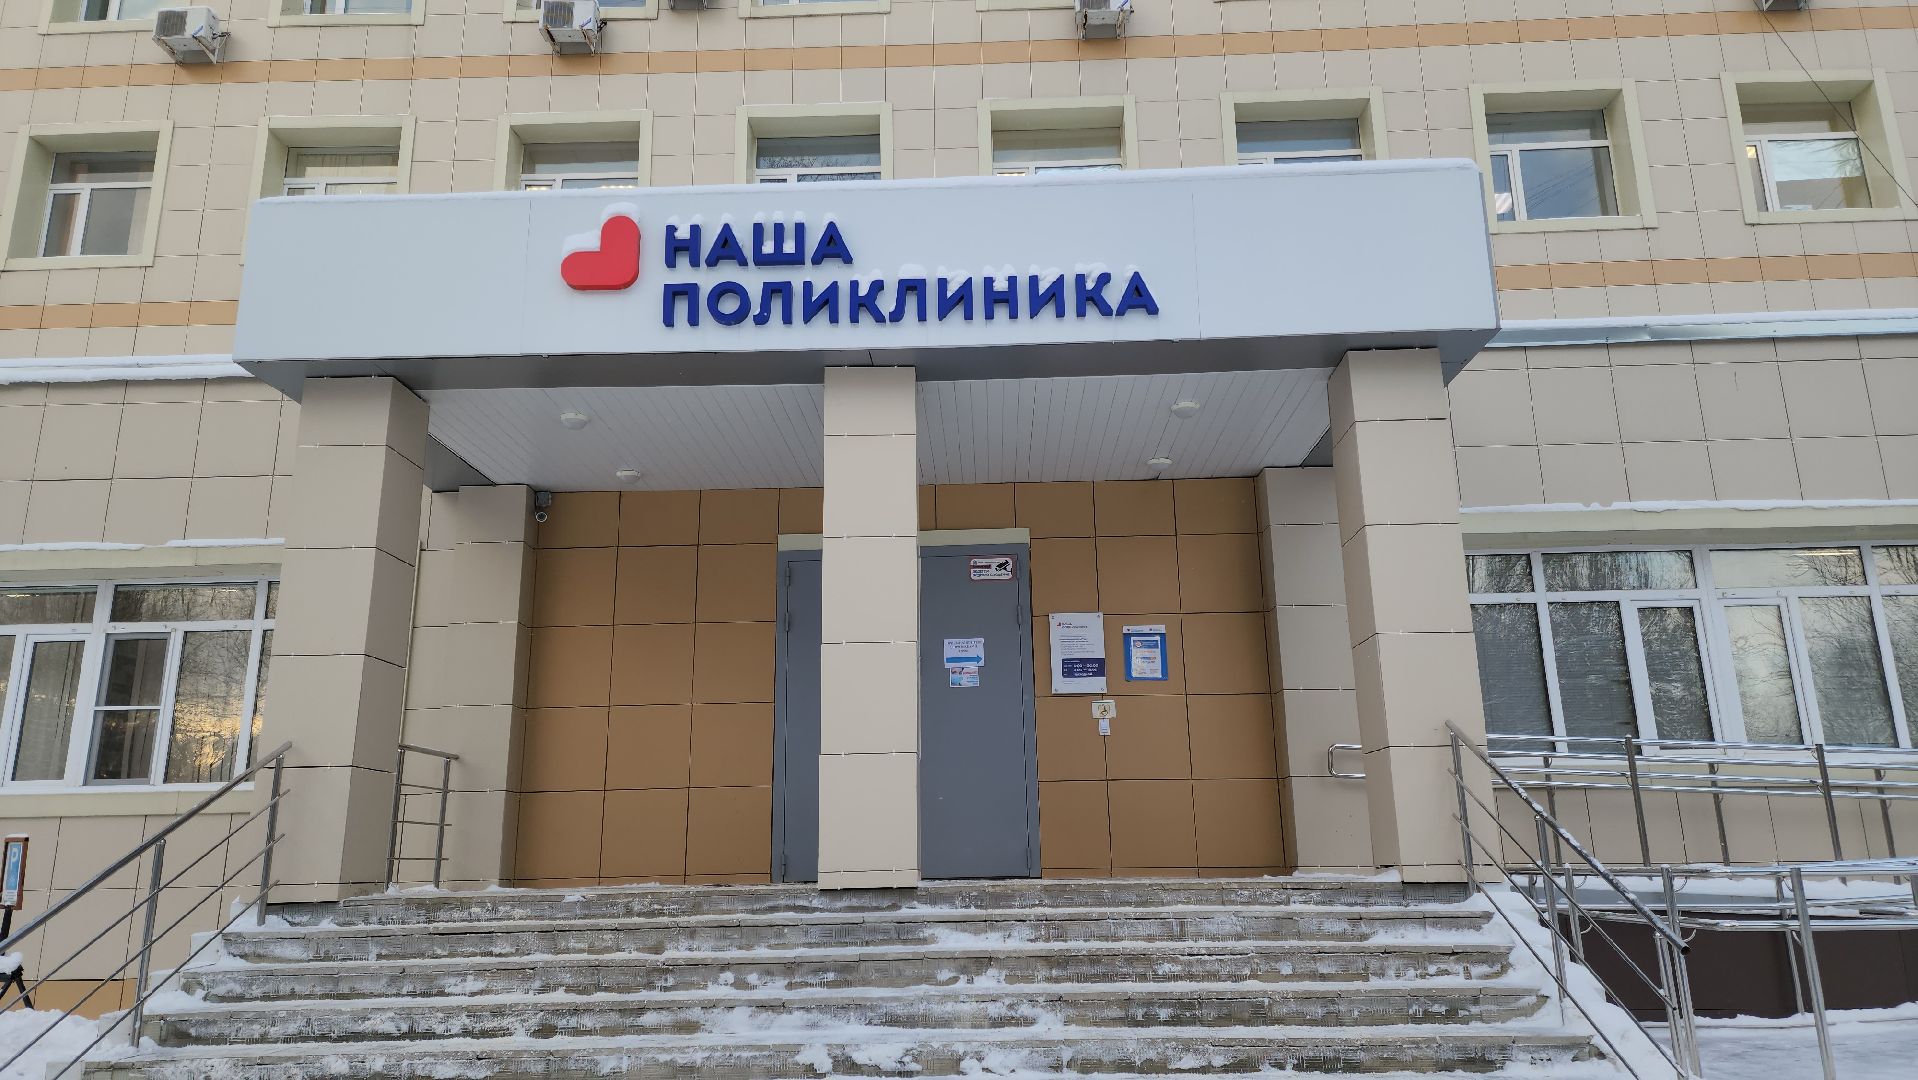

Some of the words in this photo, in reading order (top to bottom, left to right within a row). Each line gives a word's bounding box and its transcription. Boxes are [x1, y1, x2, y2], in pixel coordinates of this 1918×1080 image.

[665, 221, 853, 268] НАША
[663, 271, 1159, 327] ПОЛИКЛИНИКА
[11, 848, 18, 869] P
